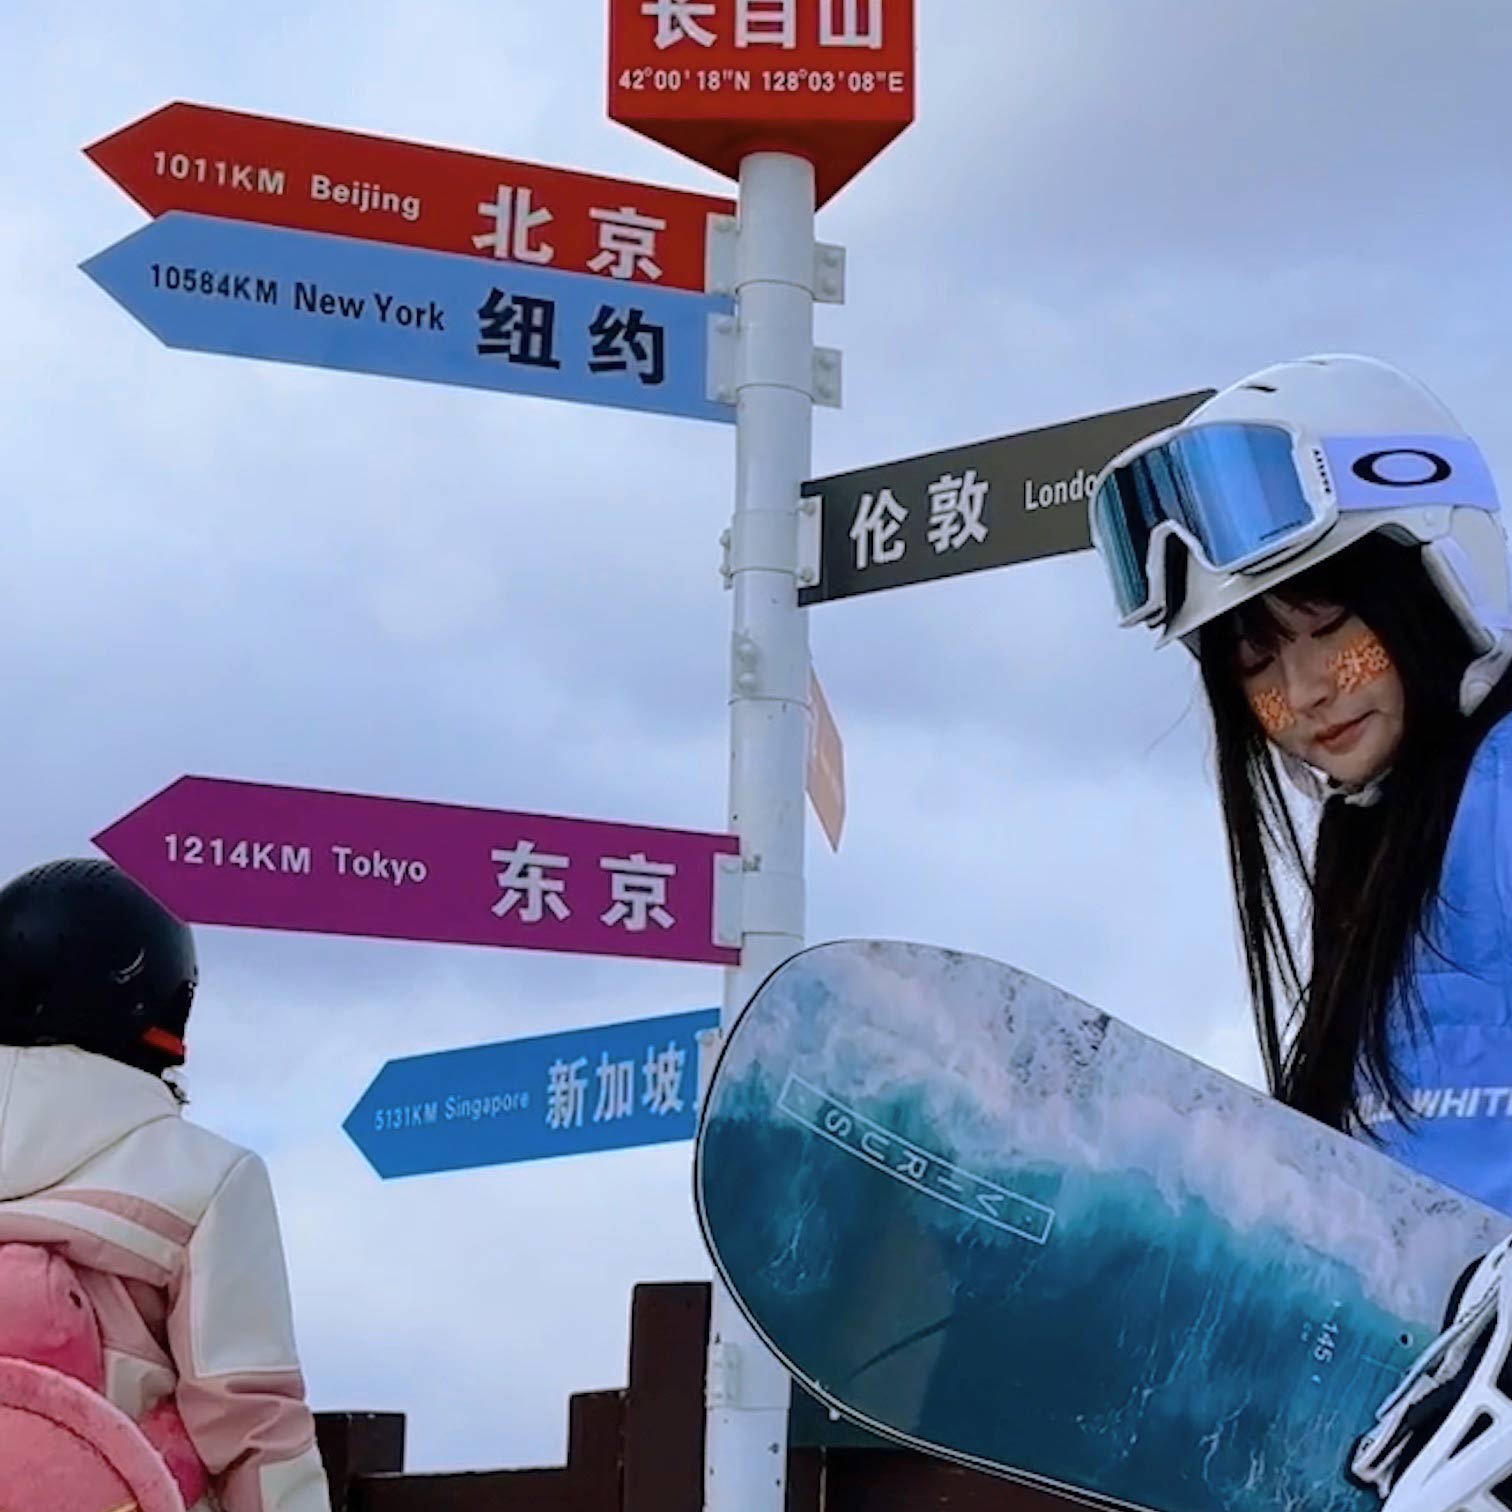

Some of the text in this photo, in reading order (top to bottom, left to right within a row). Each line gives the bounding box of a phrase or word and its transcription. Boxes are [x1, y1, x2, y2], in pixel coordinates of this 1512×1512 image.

[152, 150, 666, 281] 1011KM Beijing 北京
[148, 264, 666, 386] 10584KM New York 纽约
[850, 467, 1098, 571] 伦敦 Londo
[162, 833, 677, 931] 1214KM Tokyo 东京
[444, 1091, 530, 1122] Singapore
[545, 1040, 687, 1130] 新加坡
